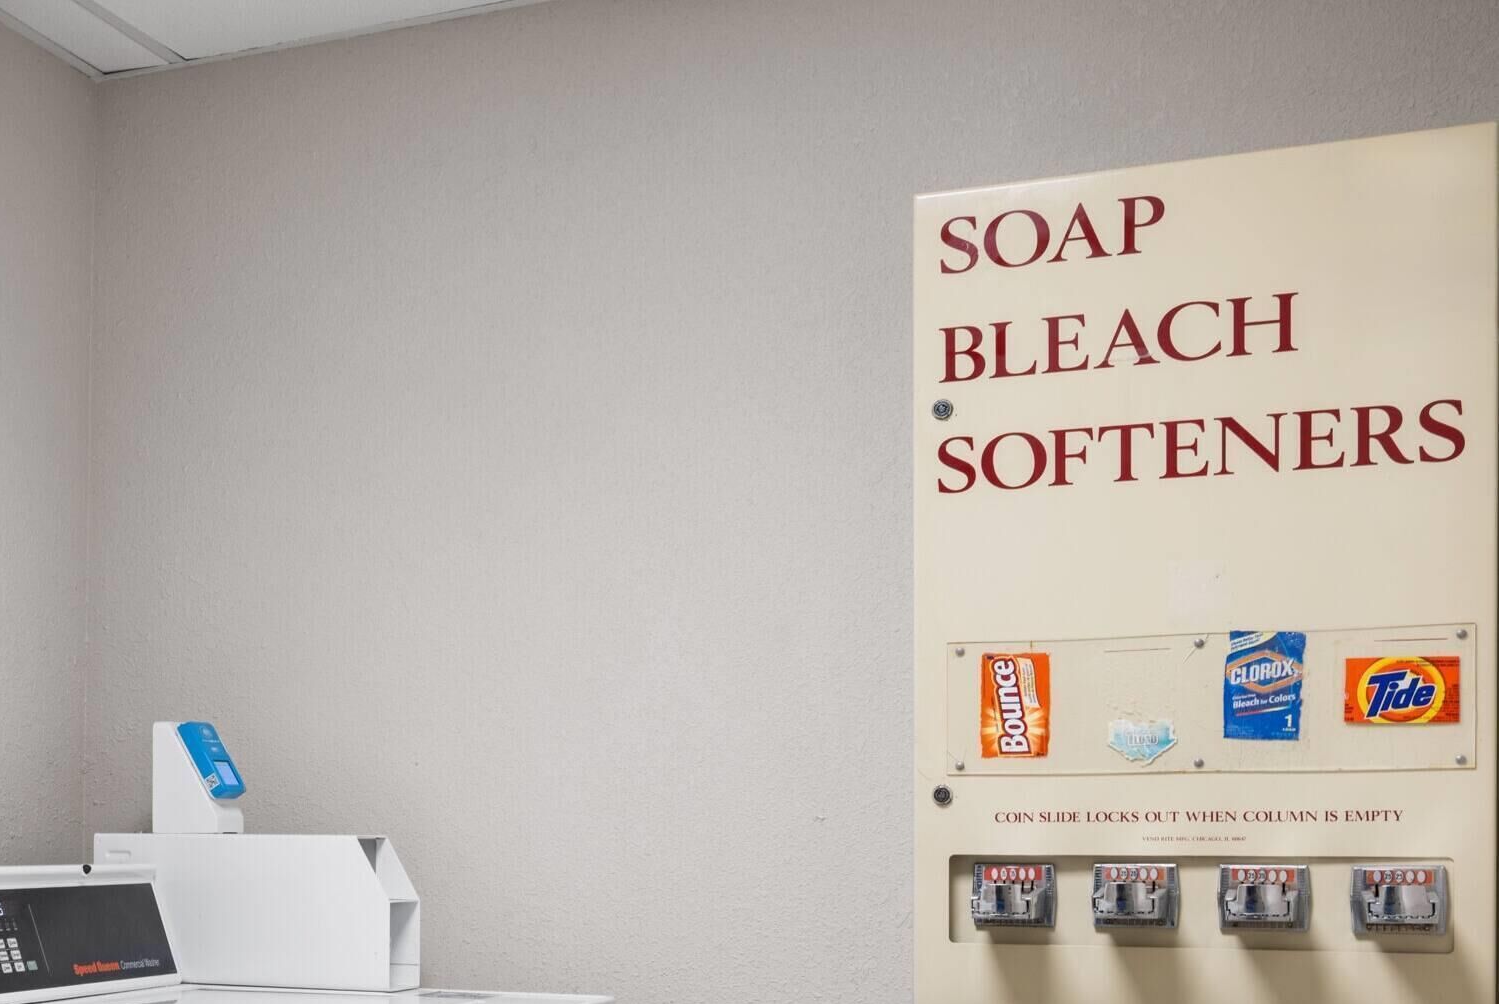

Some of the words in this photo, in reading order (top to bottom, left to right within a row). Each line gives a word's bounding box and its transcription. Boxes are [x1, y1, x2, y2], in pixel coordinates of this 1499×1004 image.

[939, 195, 1166, 275] SOAP
[938, 292, 1299, 384] BLEACH
[936, 399, 1467, 494] SOFTENERS
[1230, 658, 1294, 685] CLOROX
[1365, 669, 1437, 719] Tide
[993, 657, 1032, 756] Bounce
[1233, 697, 1260, 710] Bleach
[1268, 693, 1296, 704] Colors
[1284, 714, 1293, 728] 1
[994, 811, 1034, 824] COIN
[1038, 811, 1081, 824] SLIDE
[1086, 811, 1139, 824] LOCKS
[1144, 811, 1180, 824] OUT
[1186, 810, 1237, 823] WHEN
[1242, 810, 1318, 823] COLUMN
[1324, 810, 1338, 822] IS
[1344, 809, 1403, 822] EMPTY
